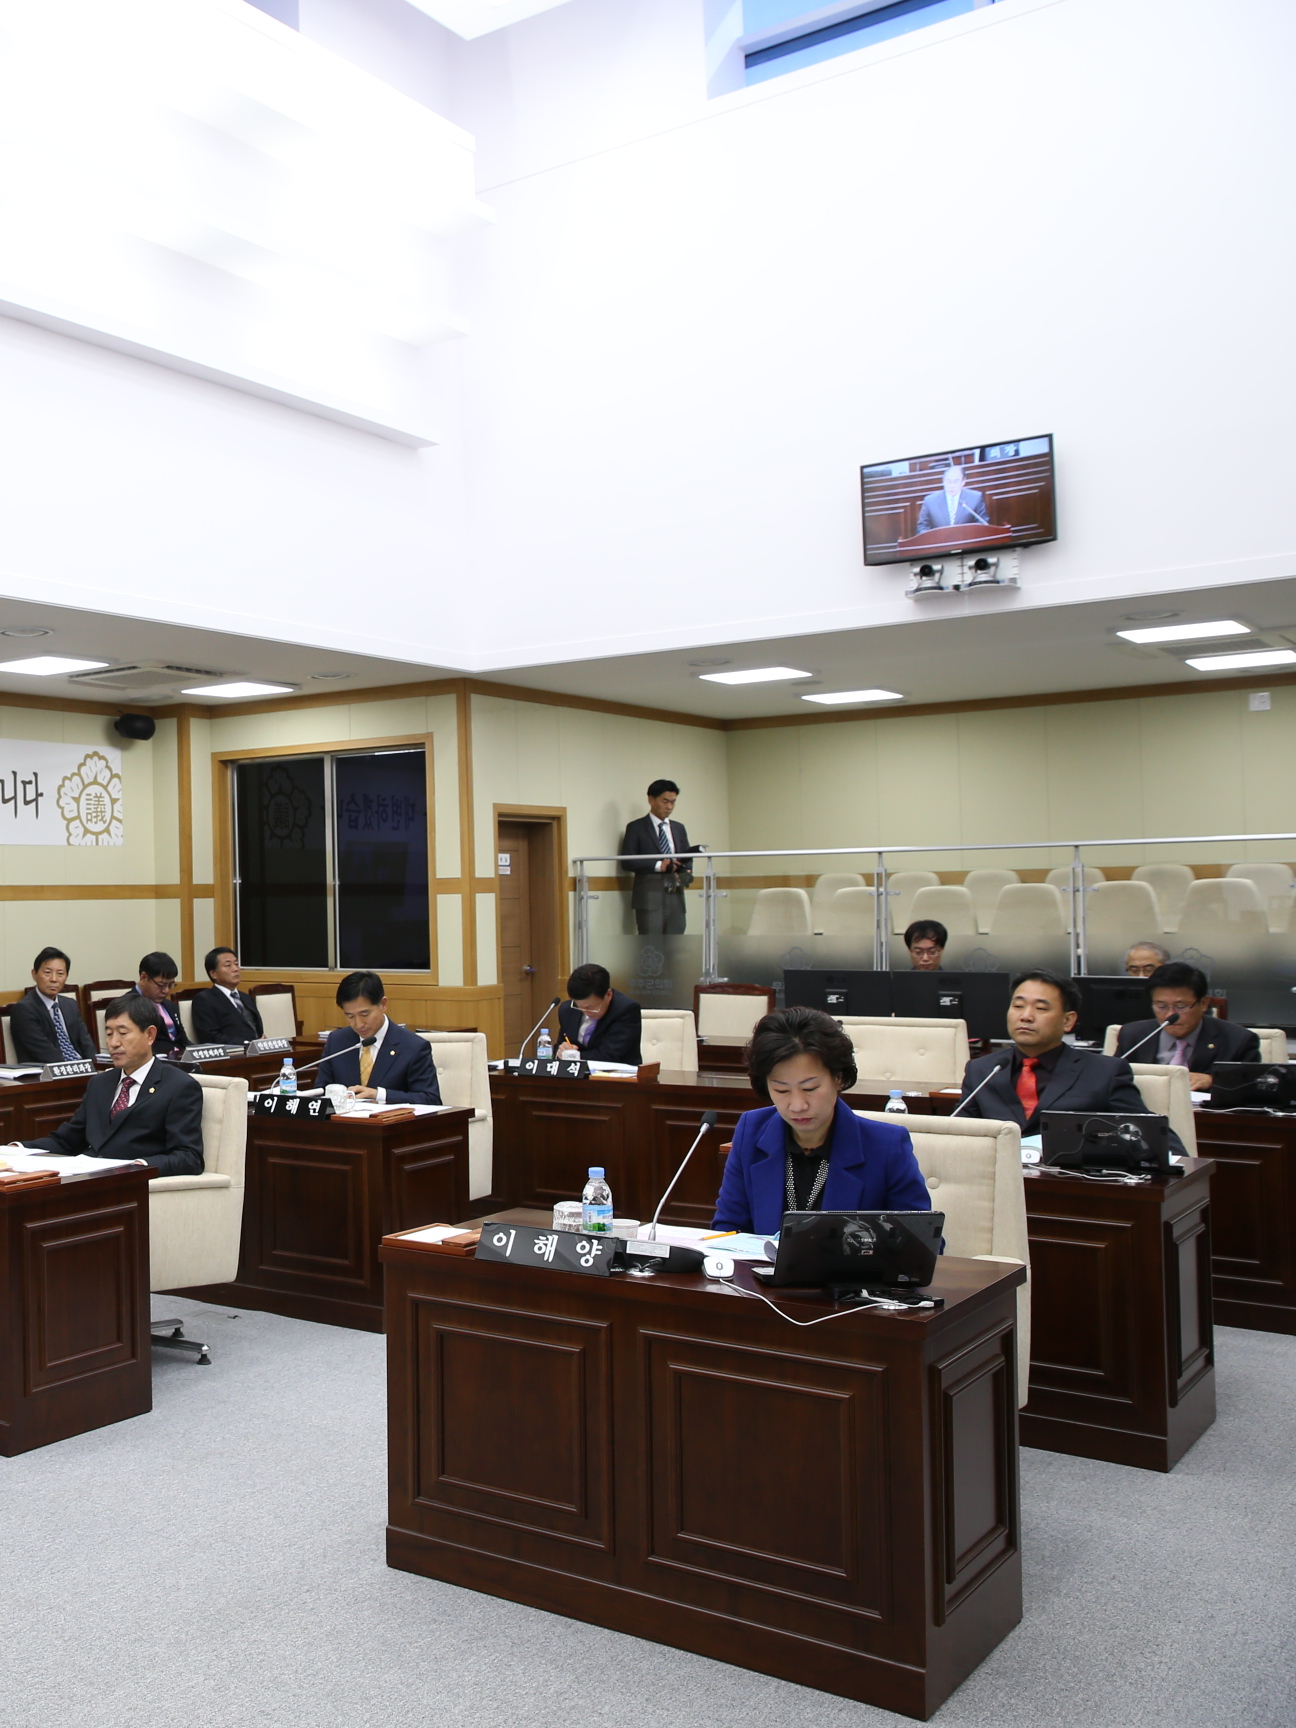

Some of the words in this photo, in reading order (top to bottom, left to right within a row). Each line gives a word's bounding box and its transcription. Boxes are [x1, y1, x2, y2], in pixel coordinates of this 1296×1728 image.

[85, 791, 107, 825] 議
[525, 1060, 581, 1077] 이대석
[492, 1229, 604, 1267] 이해양
